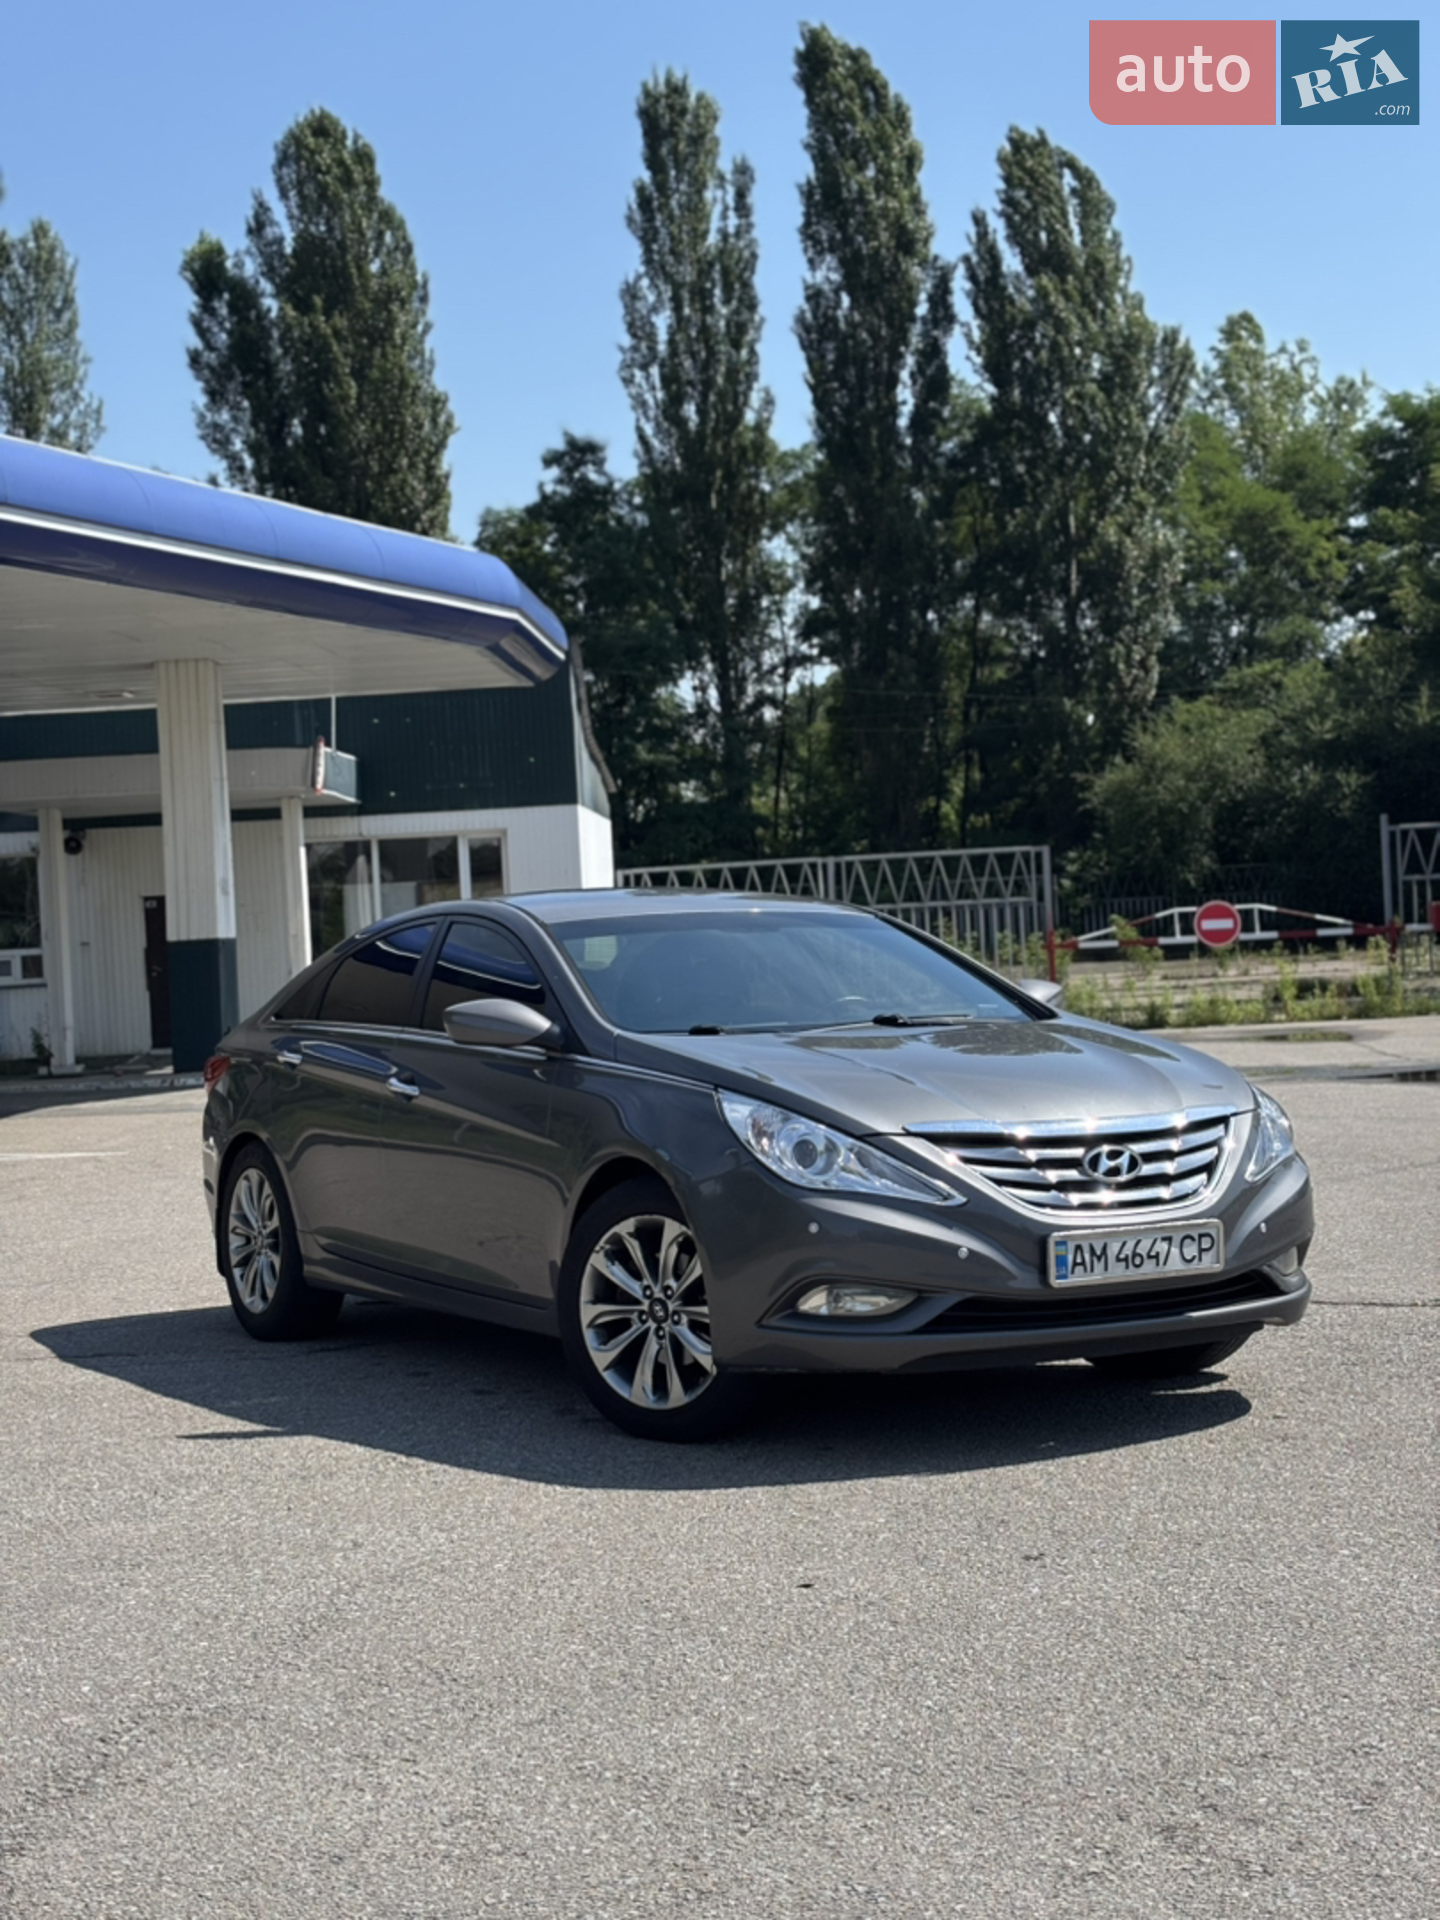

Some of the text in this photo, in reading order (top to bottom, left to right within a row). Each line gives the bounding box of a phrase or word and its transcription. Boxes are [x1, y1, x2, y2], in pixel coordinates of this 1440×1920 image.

[1070, 1232, 1215, 1275] AM 4647 CP
